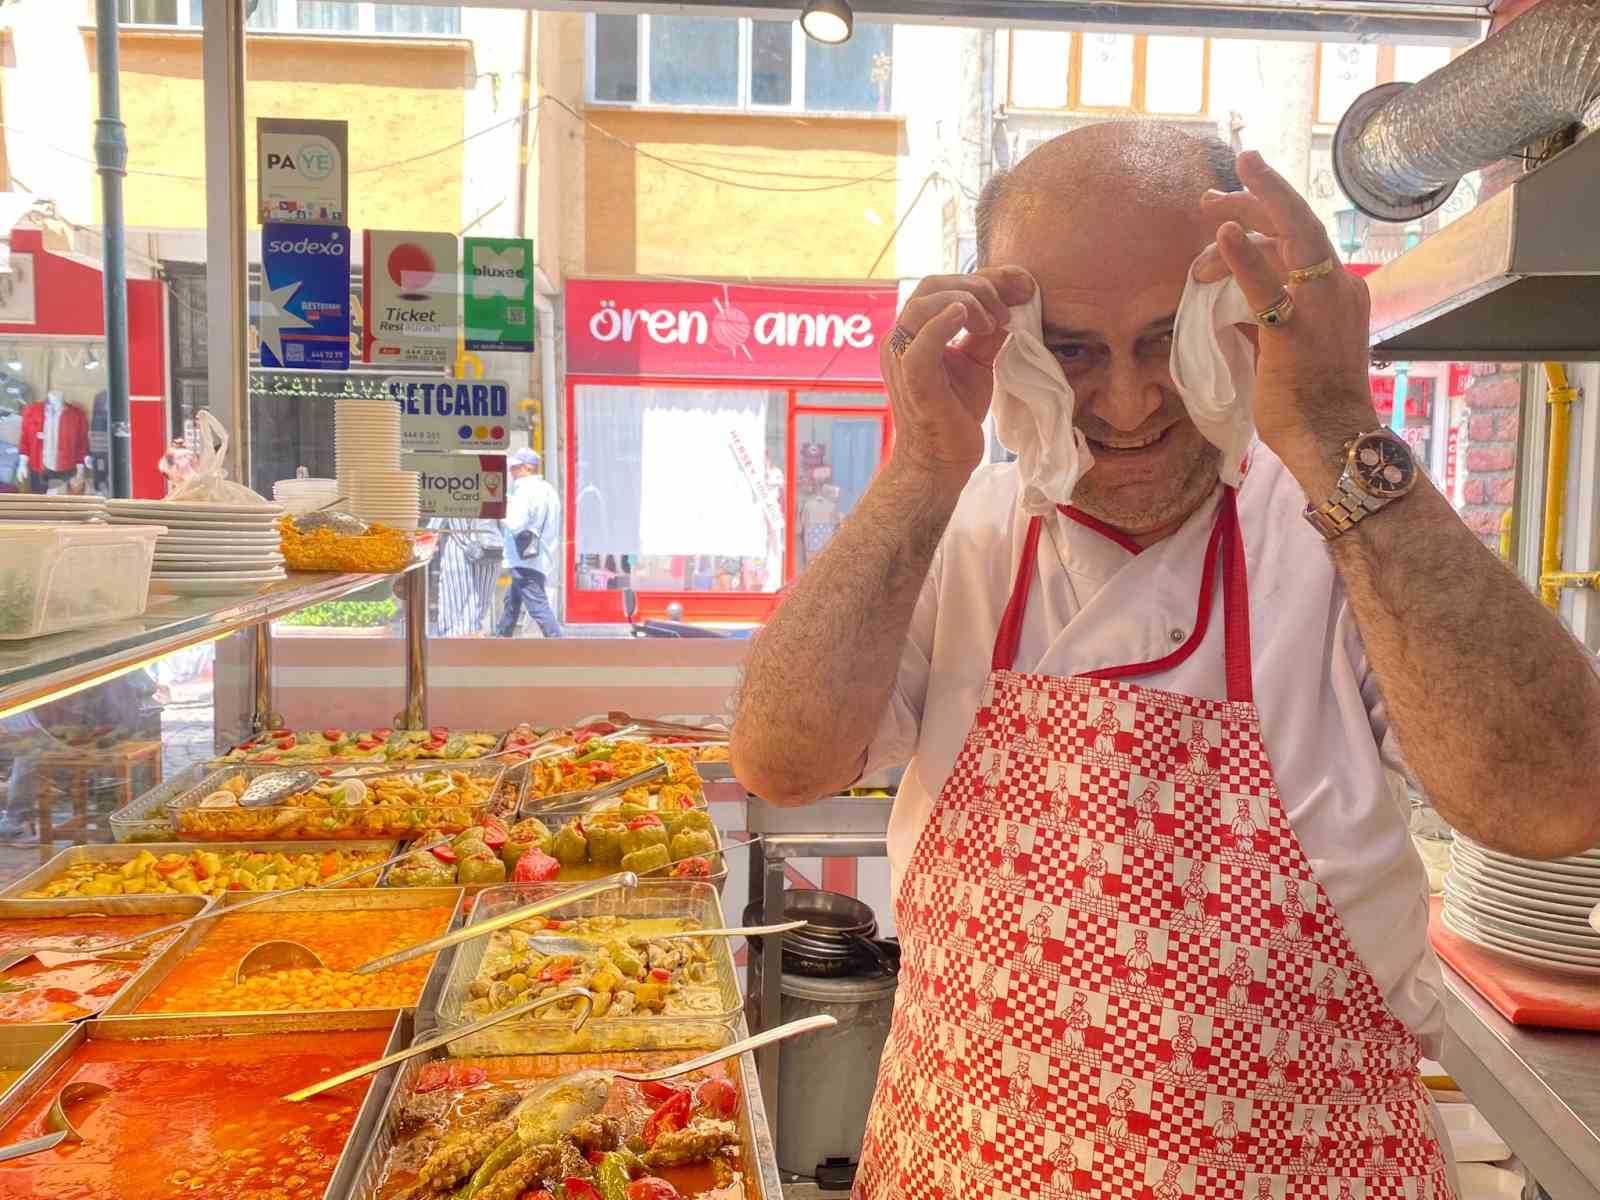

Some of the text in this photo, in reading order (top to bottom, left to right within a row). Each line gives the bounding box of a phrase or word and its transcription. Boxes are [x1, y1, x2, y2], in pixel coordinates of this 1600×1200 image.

[269, 237, 345, 256] sodexo
[385, 307, 436, 322] Ticket
[589, 300, 874, 349] ören anne
[419, 472, 480, 494] tropol
[452, 491, 480, 502] Card
